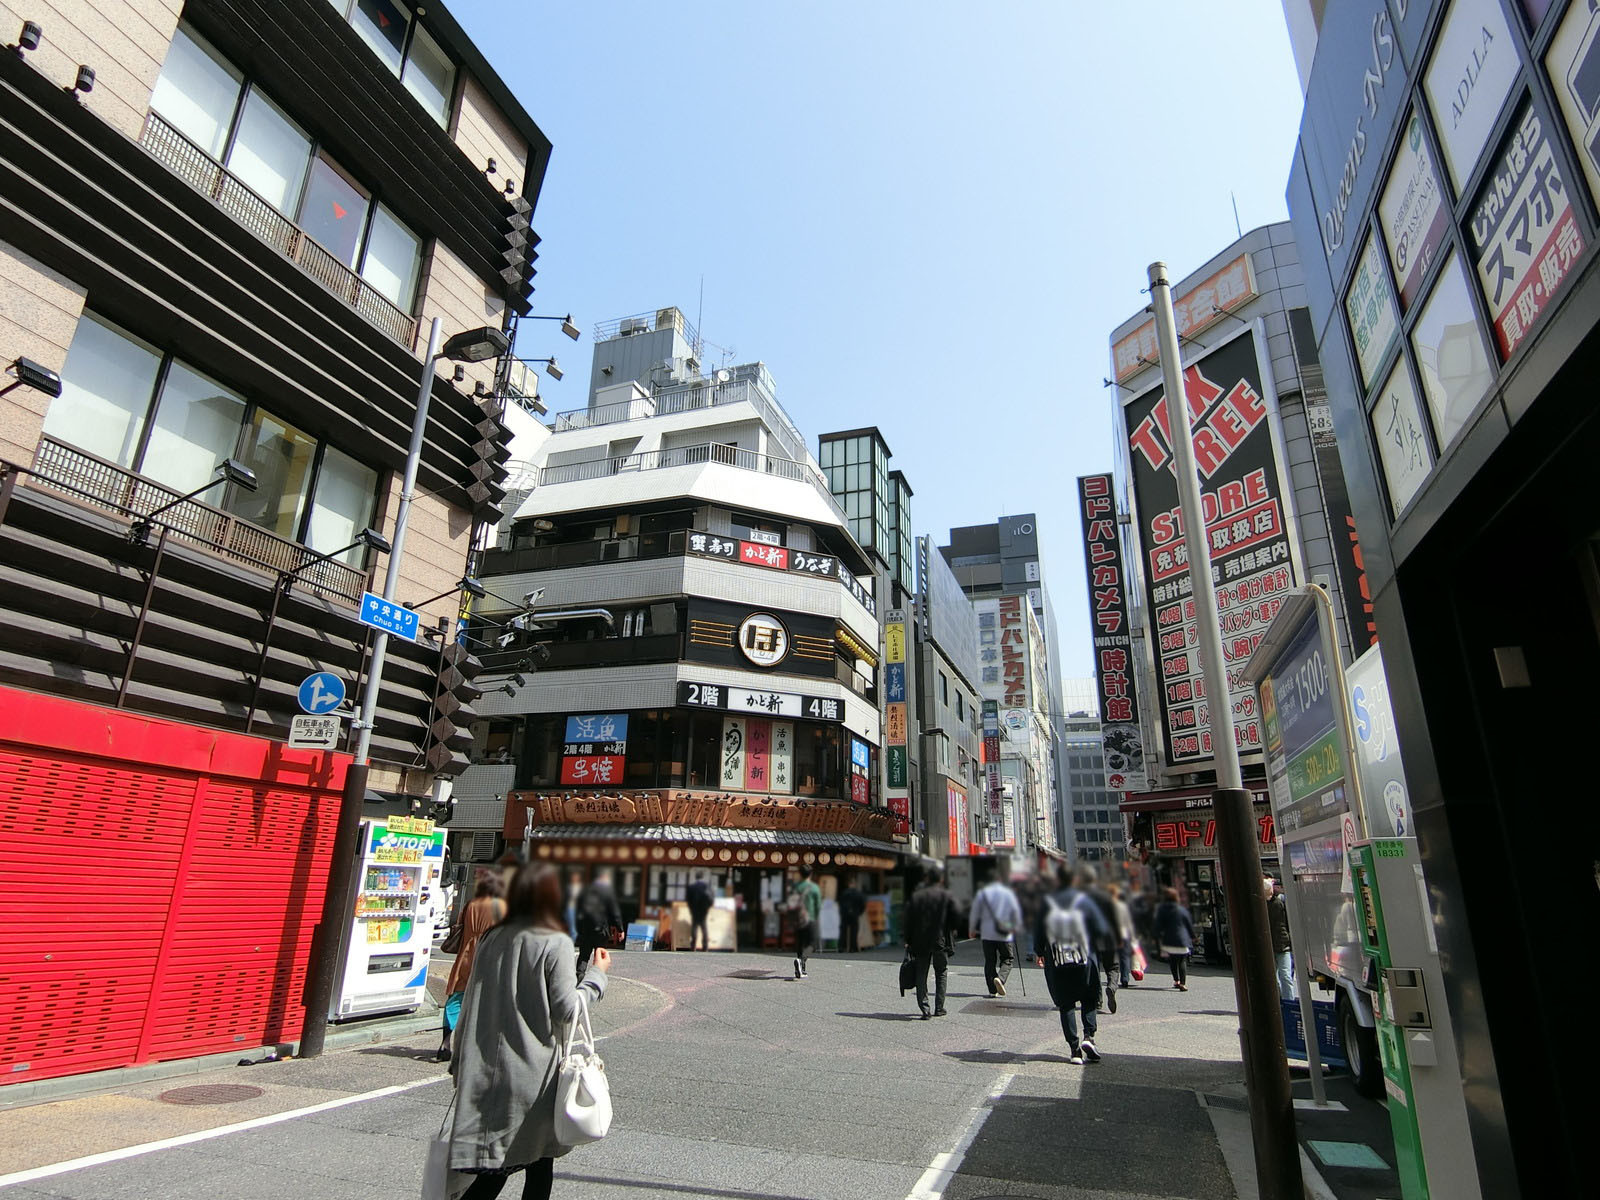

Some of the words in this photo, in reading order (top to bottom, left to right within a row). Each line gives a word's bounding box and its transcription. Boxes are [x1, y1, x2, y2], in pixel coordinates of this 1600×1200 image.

[1452, 26, 1494, 130] ADLLA
[1323, 115, 1367, 256] Queens
[1363, 9, 1395, 119] NS
[1470, 105, 1541, 248] じゃんぱら
[1485, 156, 1562, 307] スマホ
[1501, 216, 1582, 353] 買取・販売
[1167, 377, 1268, 490] REE
[1156, 508, 1274, 573] 免税取扱店
[745, 546, 784, 568] かど新
[794, 552, 833, 575] うなぎ
[1083, 477, 1121, 635] ヨドバシカメラ
[1225, 541, 1289, 579] 売場案内
[1158, 604, 1182, 626] 4階
[1184, 568, 1290, 622] 置計・掛け時計
[369, 600, 413, 626] 中央通り
[373, 614, 393, 628] Chuo
[1094, 633, 1130, 648] WATCH
[1161, 628, 1185, 651] 3階
[889, 666, 904, 700] かど新
[1164, 659, 1189, 677] 2階
[1101, 647, 1133, 723] 時計館
[1168, 682, 1192, 702] 1階
[687, 684, 720, 707] 2階
[746, 693, 784, 715] かど新
[809, 698, 838, 719] 4階
[294, 728, 335, 738] 一方通行
[295, 718, 336, 730] 自転車を除く
[575, 715, 618, 741] 活魚
[563, 744, 578, 755] 2階
[578, 743, 593, 755] 4階
[750, 729, 765, 781] かど新
[776, 727, 787, 785] 活魚・串焼
[572, 757, 613, 784] 串焼
[397, 837, 418, 849] ITO
[418, 838, 435, 850] EN
[1377, 849, 1405, 858] 18331
